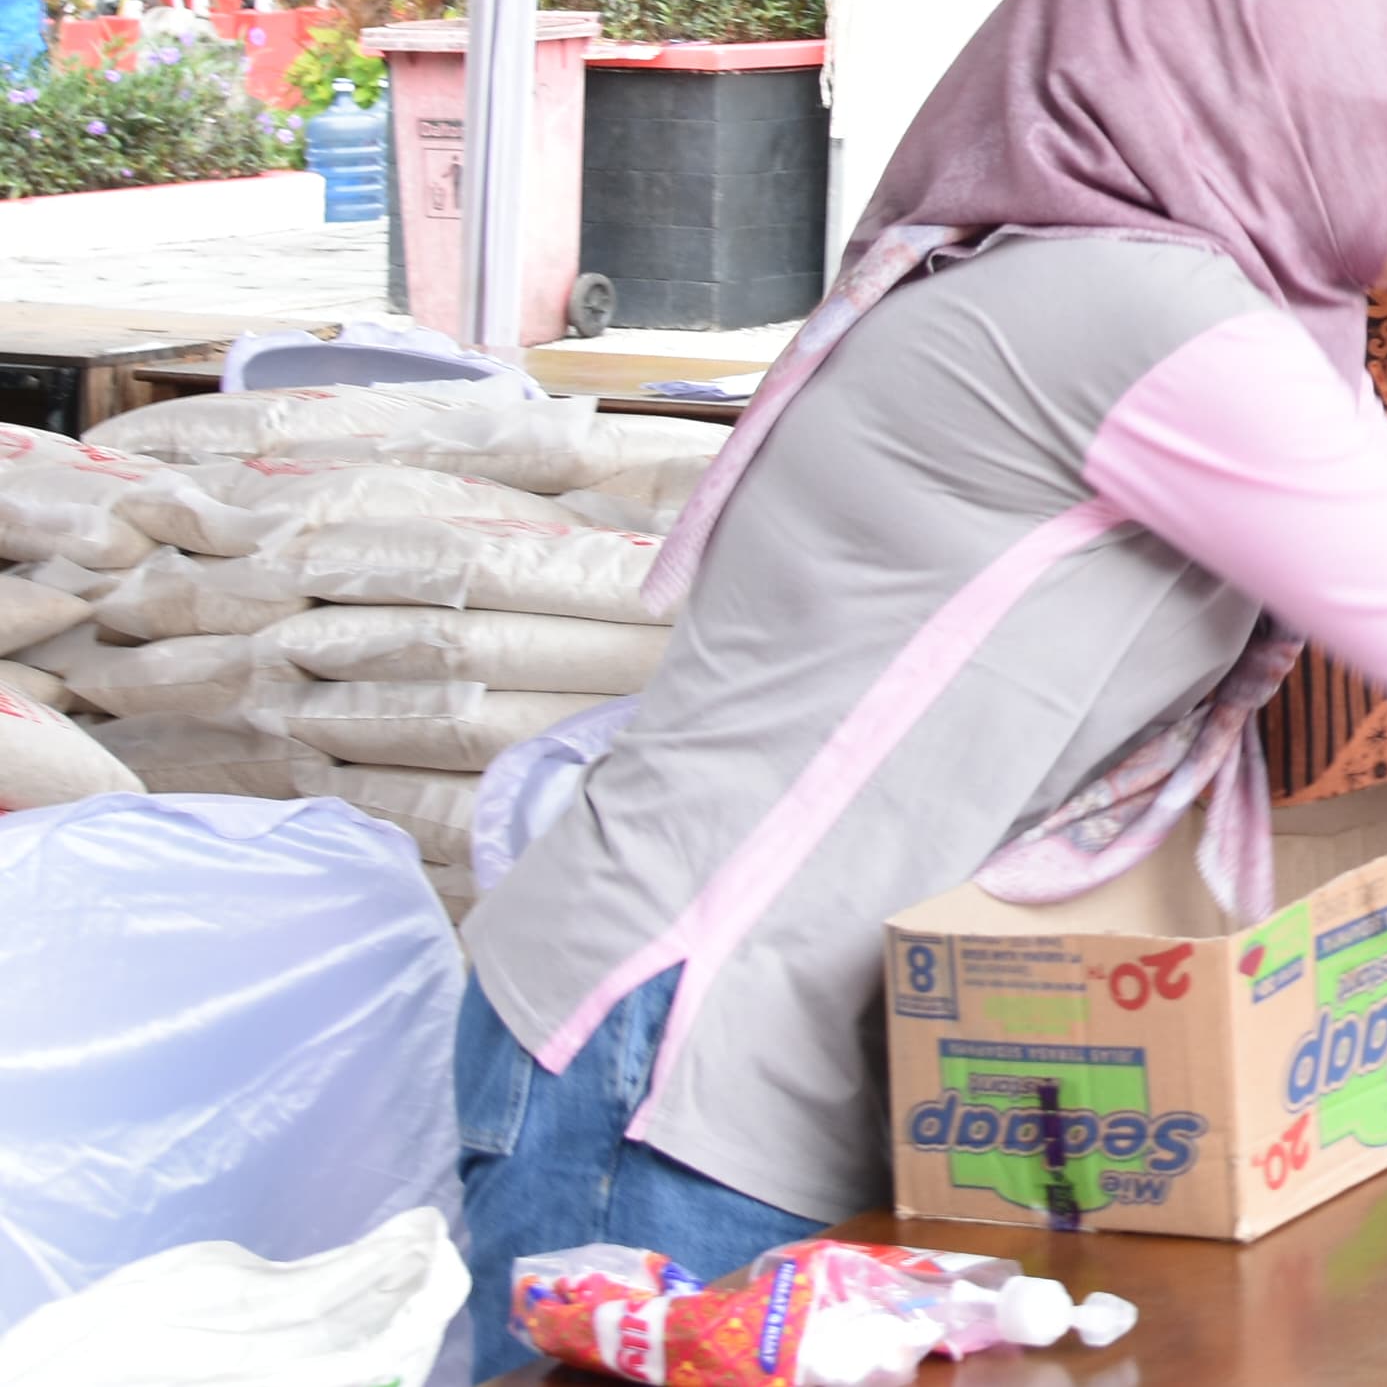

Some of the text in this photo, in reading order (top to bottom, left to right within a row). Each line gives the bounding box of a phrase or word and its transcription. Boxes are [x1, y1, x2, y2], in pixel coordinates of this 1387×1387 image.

[906, 945, 935, 993] 8
[910, 1089, 1208, 1175] Sedaap
[1100, 1171, 1173, 1204] Mie
